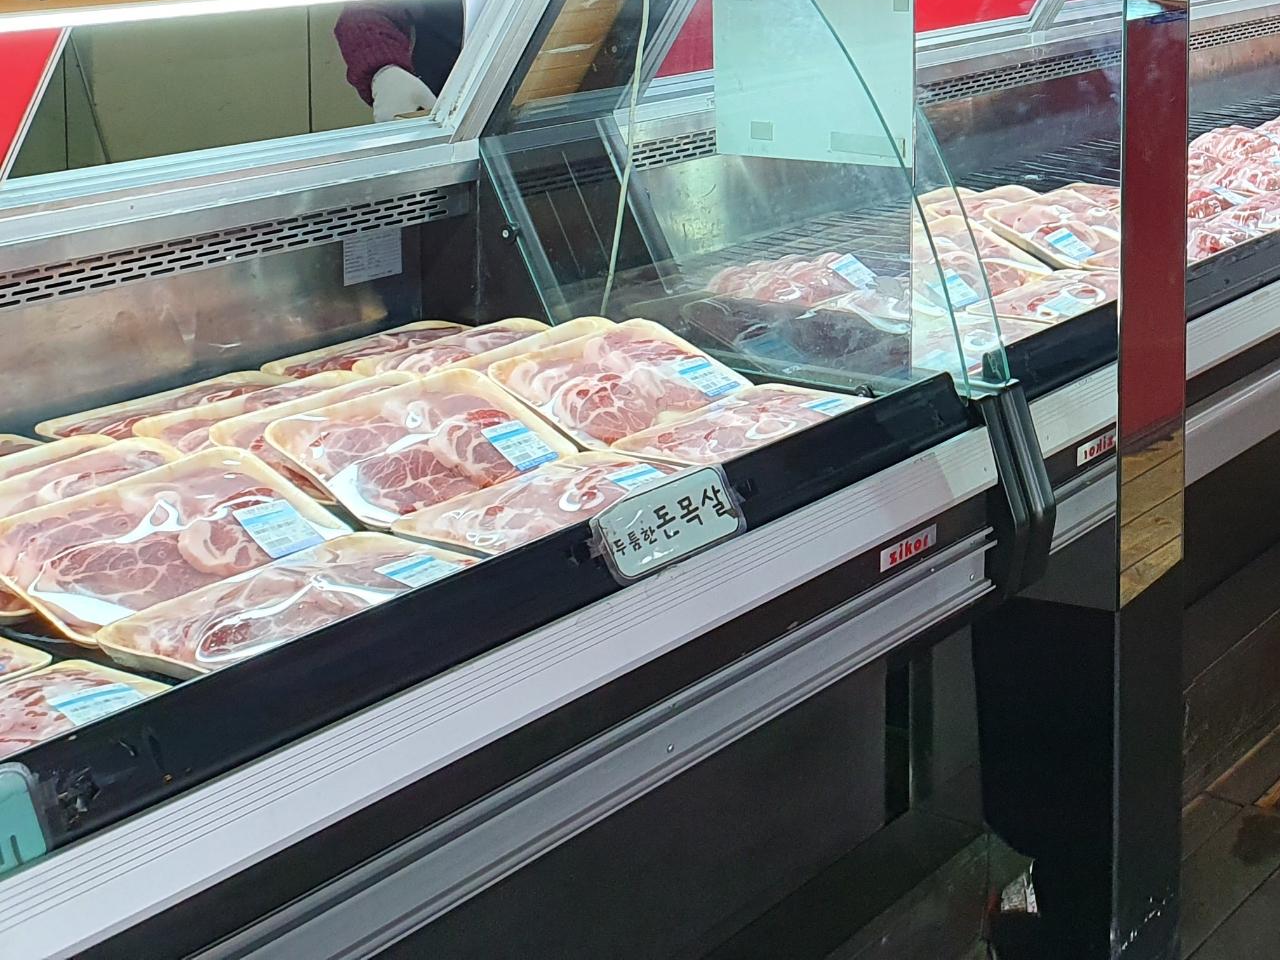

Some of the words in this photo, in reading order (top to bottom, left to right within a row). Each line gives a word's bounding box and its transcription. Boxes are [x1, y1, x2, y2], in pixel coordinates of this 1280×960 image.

[613, 526, 658, 556] 두툼한
[653, 484, 726, 540] 돈목살
[888, 537, 930, 567] zikor
